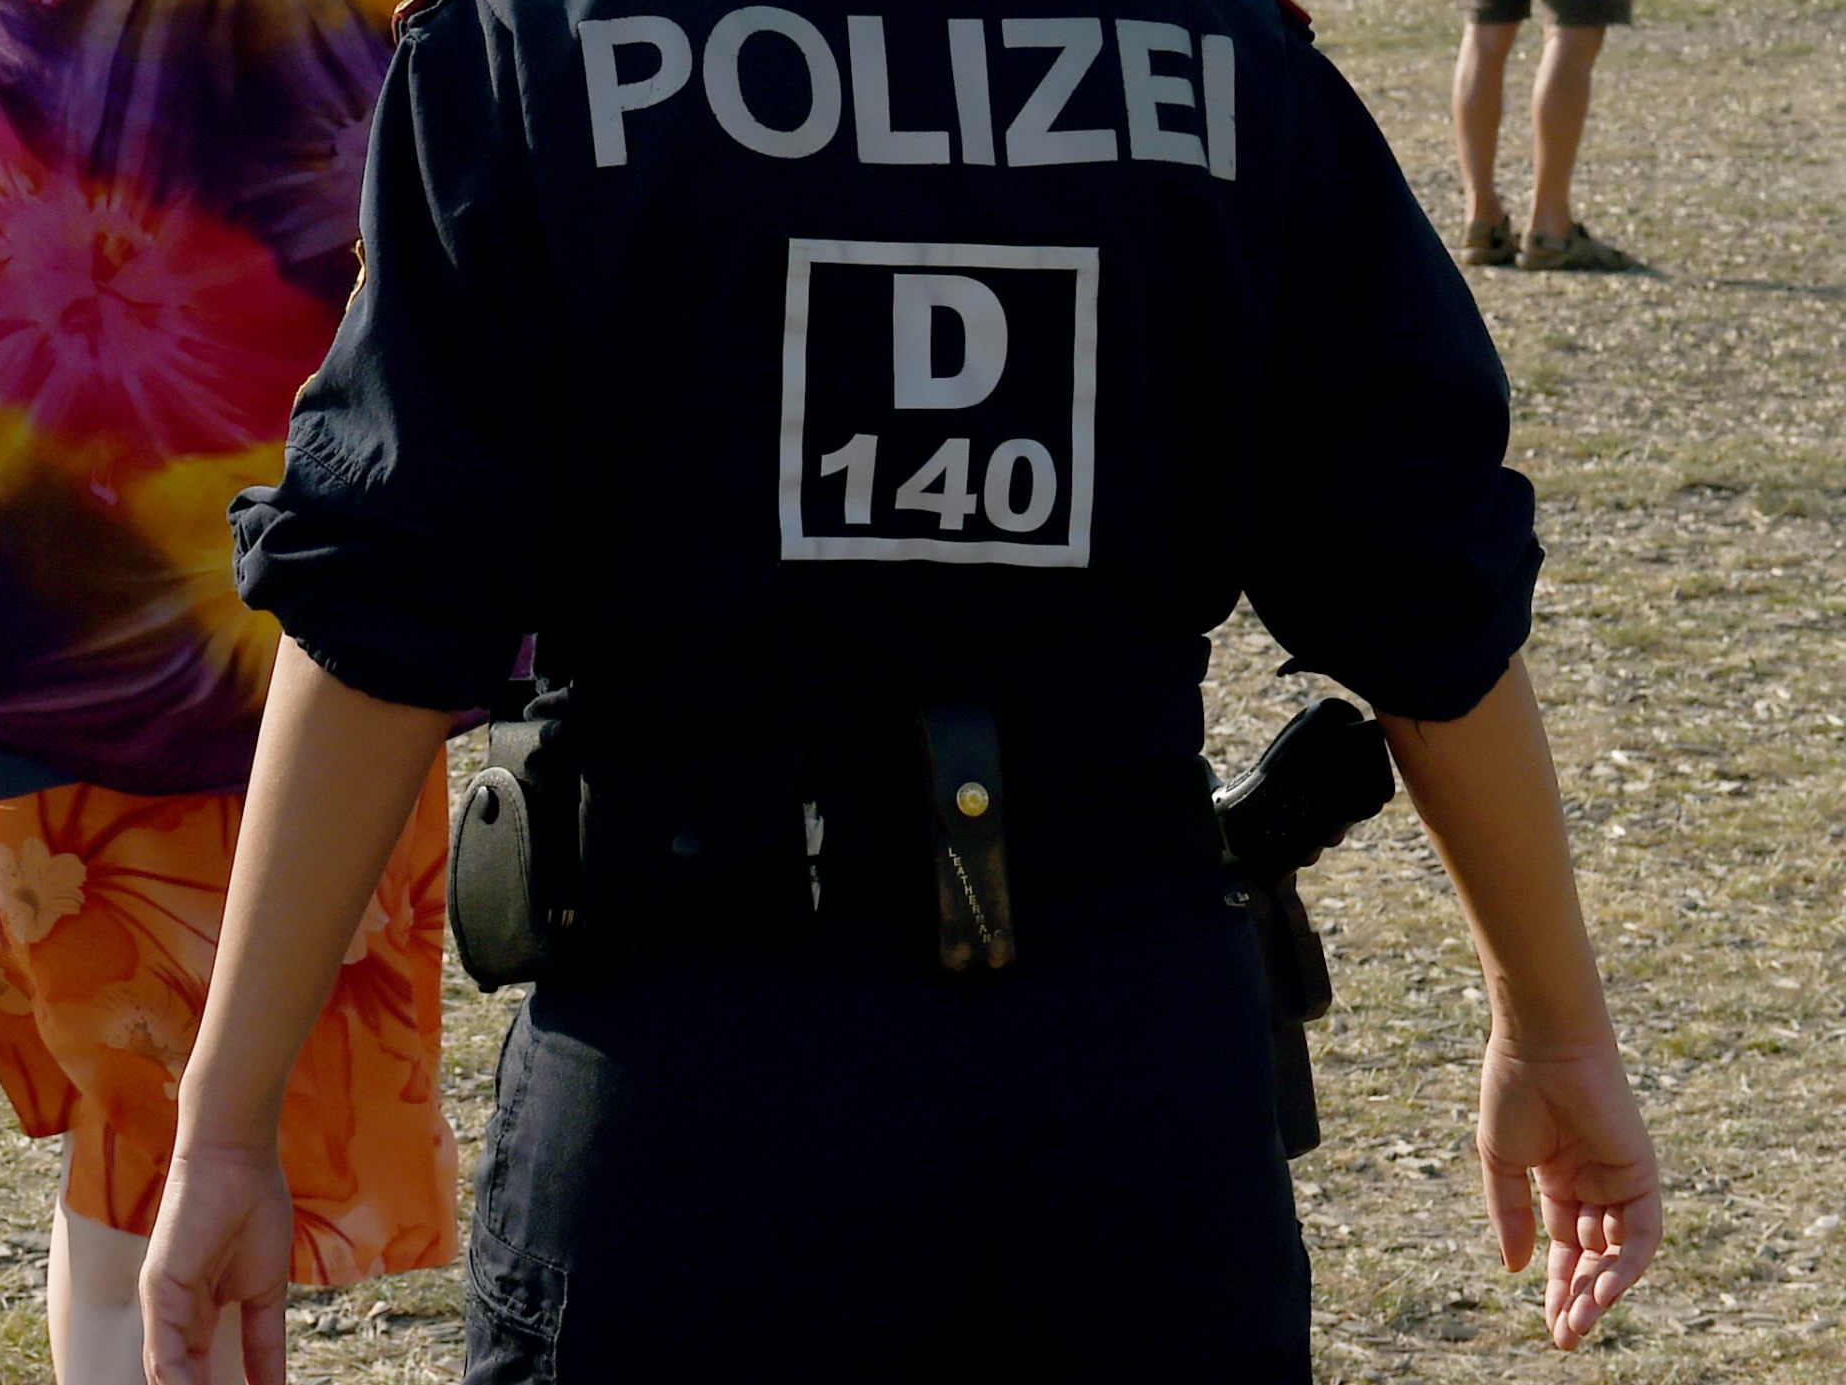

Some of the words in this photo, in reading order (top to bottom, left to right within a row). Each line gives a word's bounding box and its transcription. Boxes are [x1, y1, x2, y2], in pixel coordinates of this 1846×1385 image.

[578, 6, 1236, 182] POLIZEI
[893, 273, 1009, 410] D
[820, 433, 1057, 533] 140
[948, 846, 992, 945] LEATHERMAN
